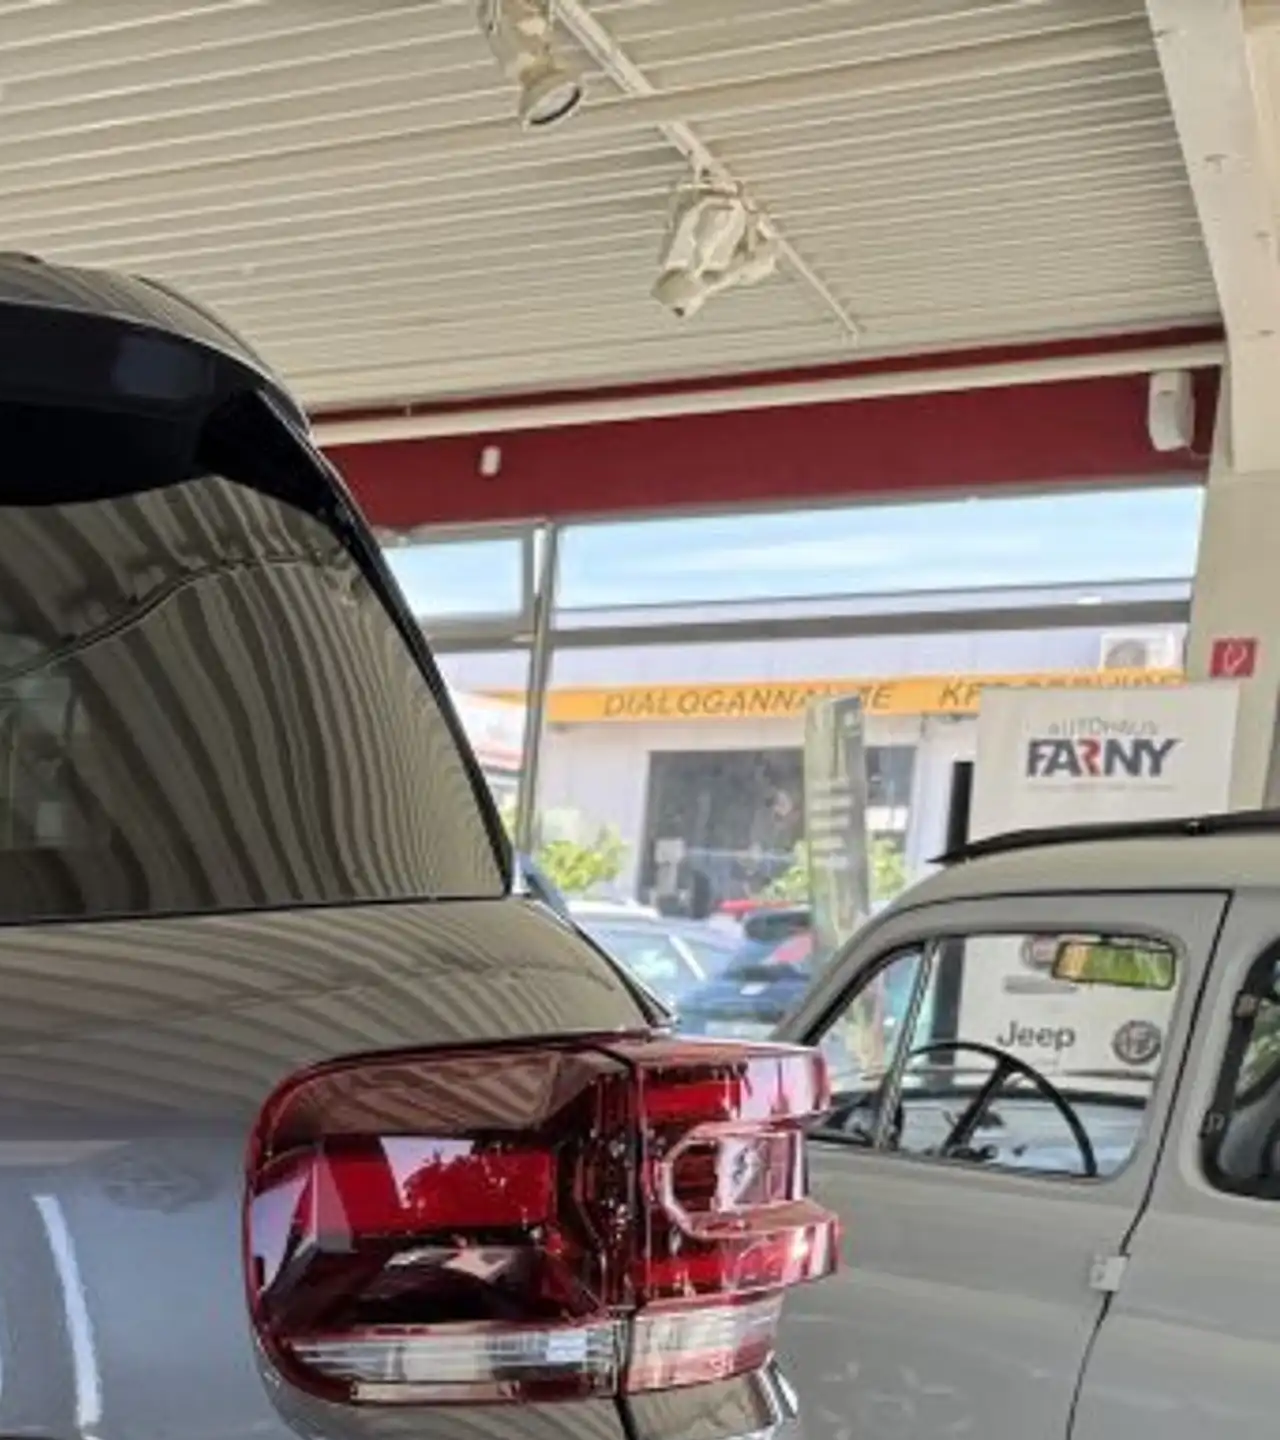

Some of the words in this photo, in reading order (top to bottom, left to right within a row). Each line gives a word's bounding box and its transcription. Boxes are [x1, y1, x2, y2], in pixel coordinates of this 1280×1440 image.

[603, 682, 892, 716] DIALOGANNE
[1026, 737, 1183, 778] FARNY
[996, 1020, 1075, 1050] Jeep
